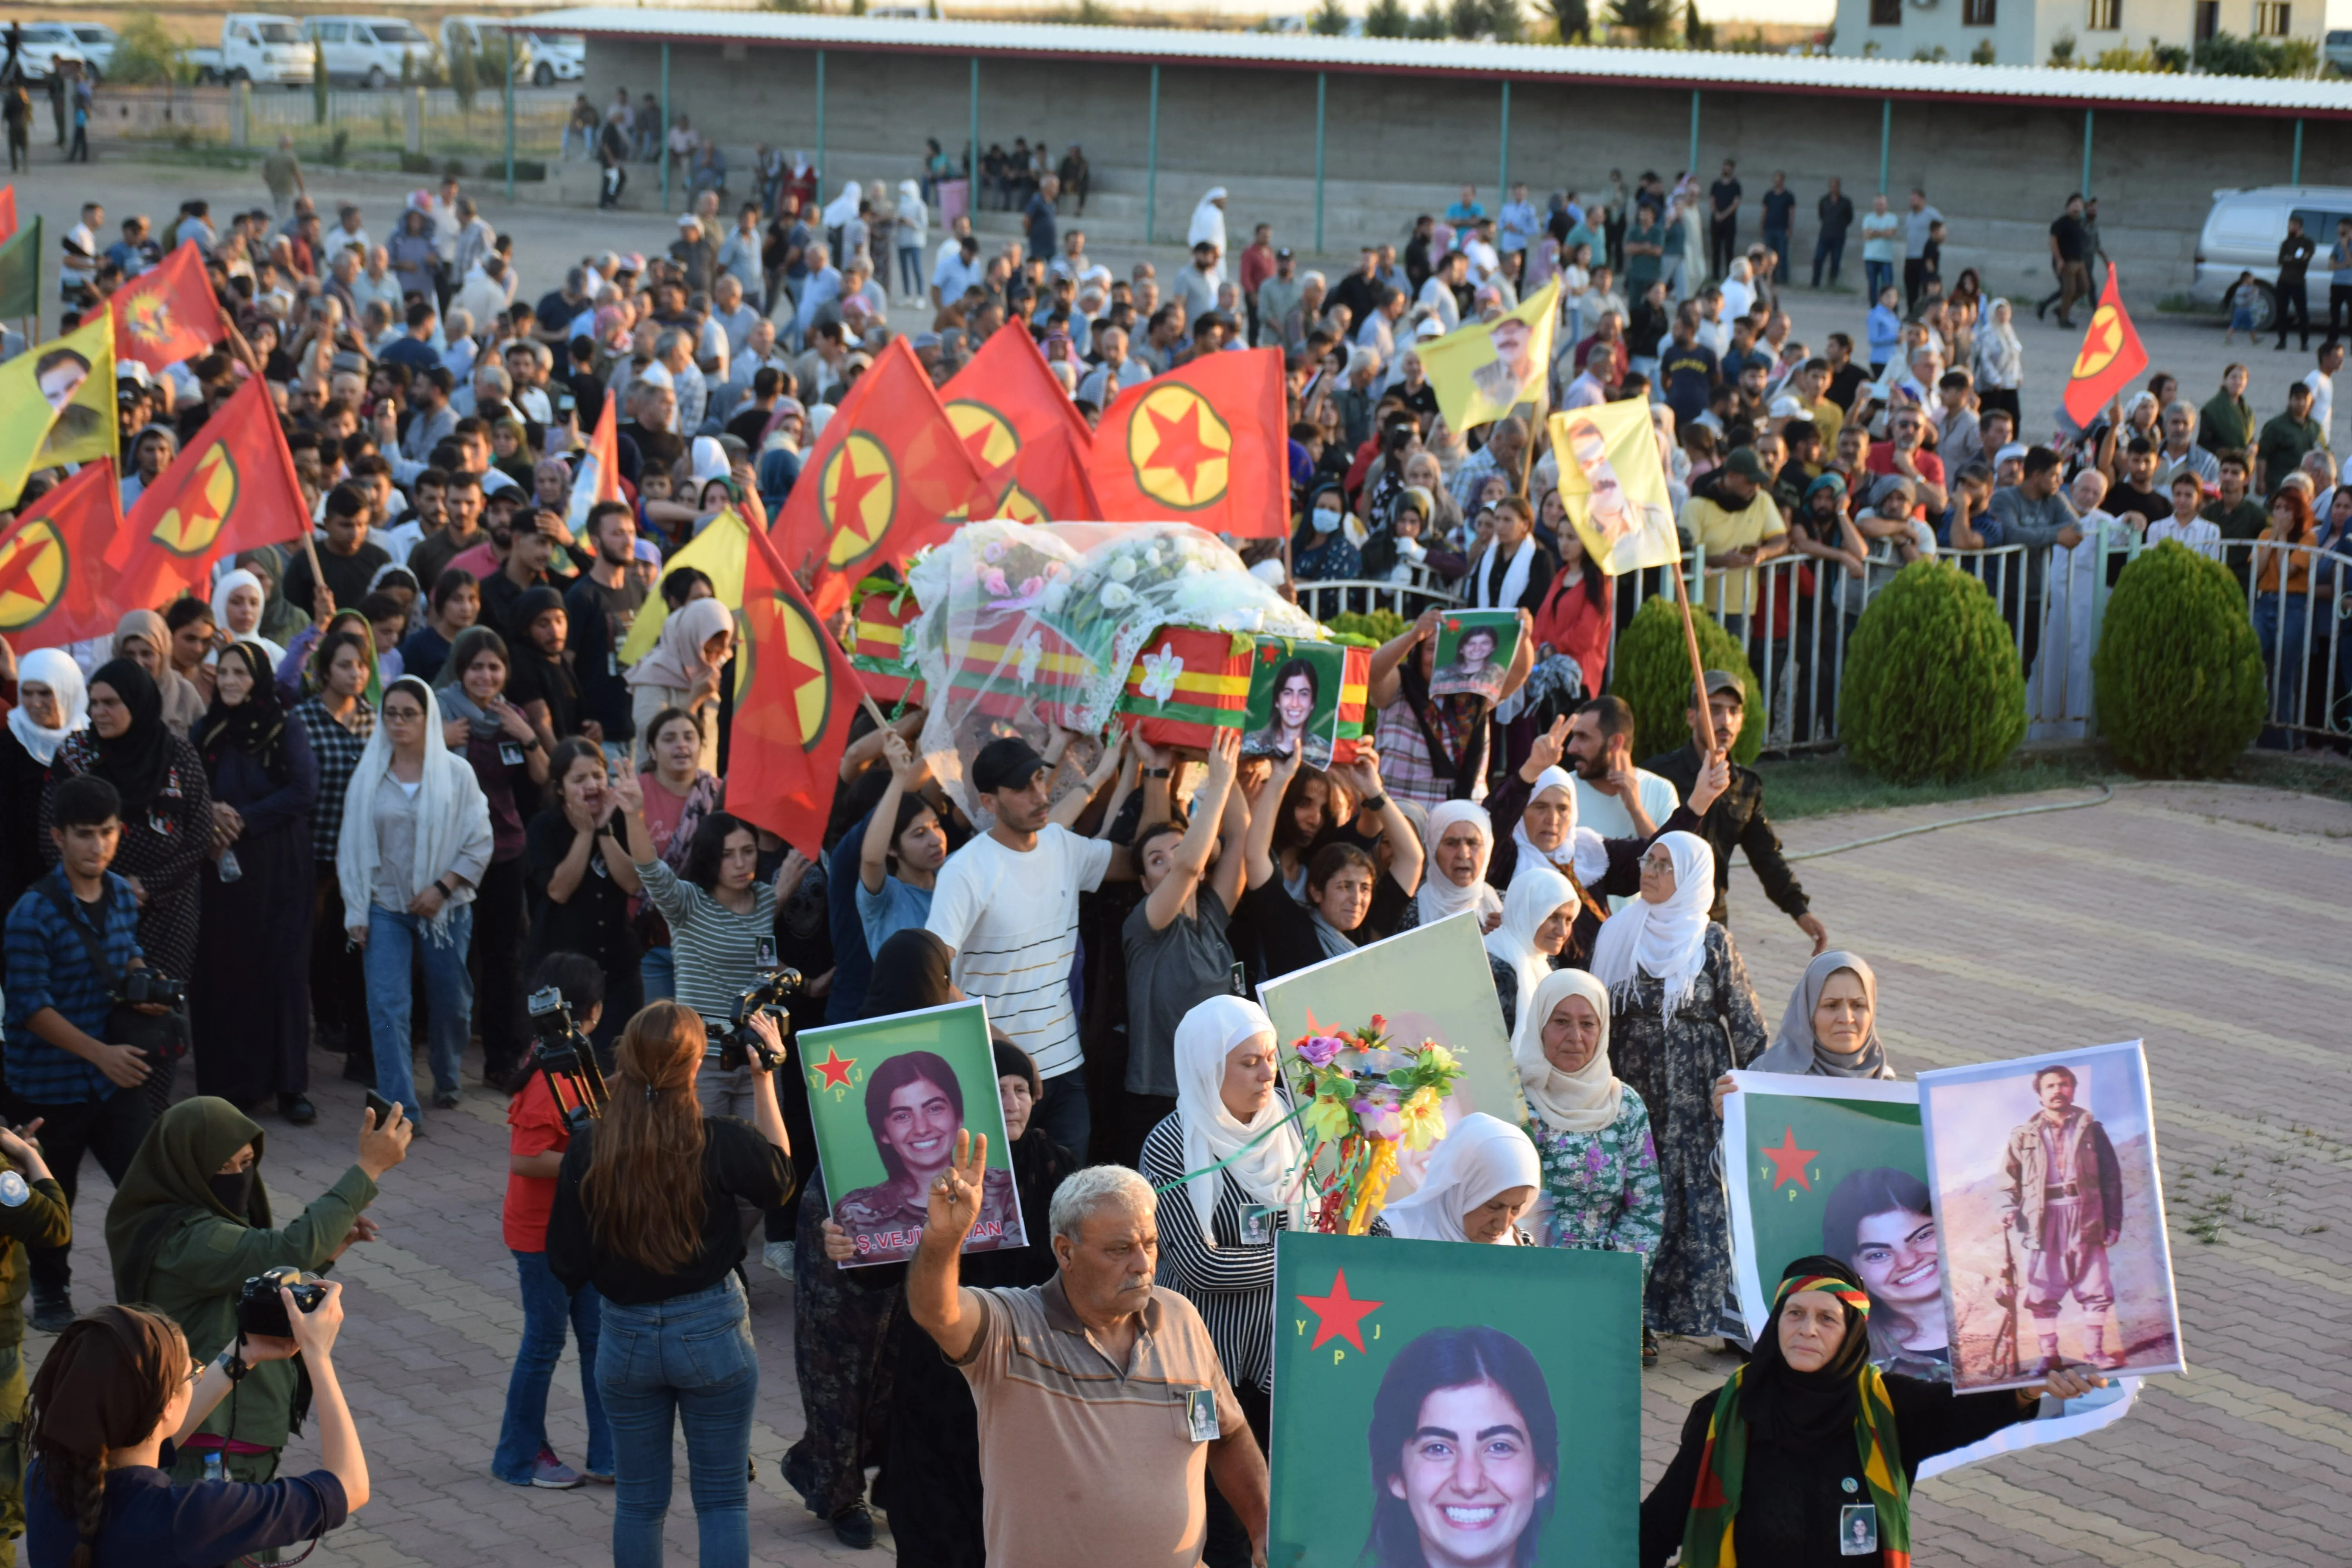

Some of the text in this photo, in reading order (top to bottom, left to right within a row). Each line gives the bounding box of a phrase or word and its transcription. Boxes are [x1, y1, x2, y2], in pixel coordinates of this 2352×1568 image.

[808, 1068, 862, 1102] Y P J
[1761, 1167, 1820, 1201] Y P J
[856, 1220, 1002, 1254] Ş.VEJÎ AN
[1296, 1319, 1381, 1365] Y P J
